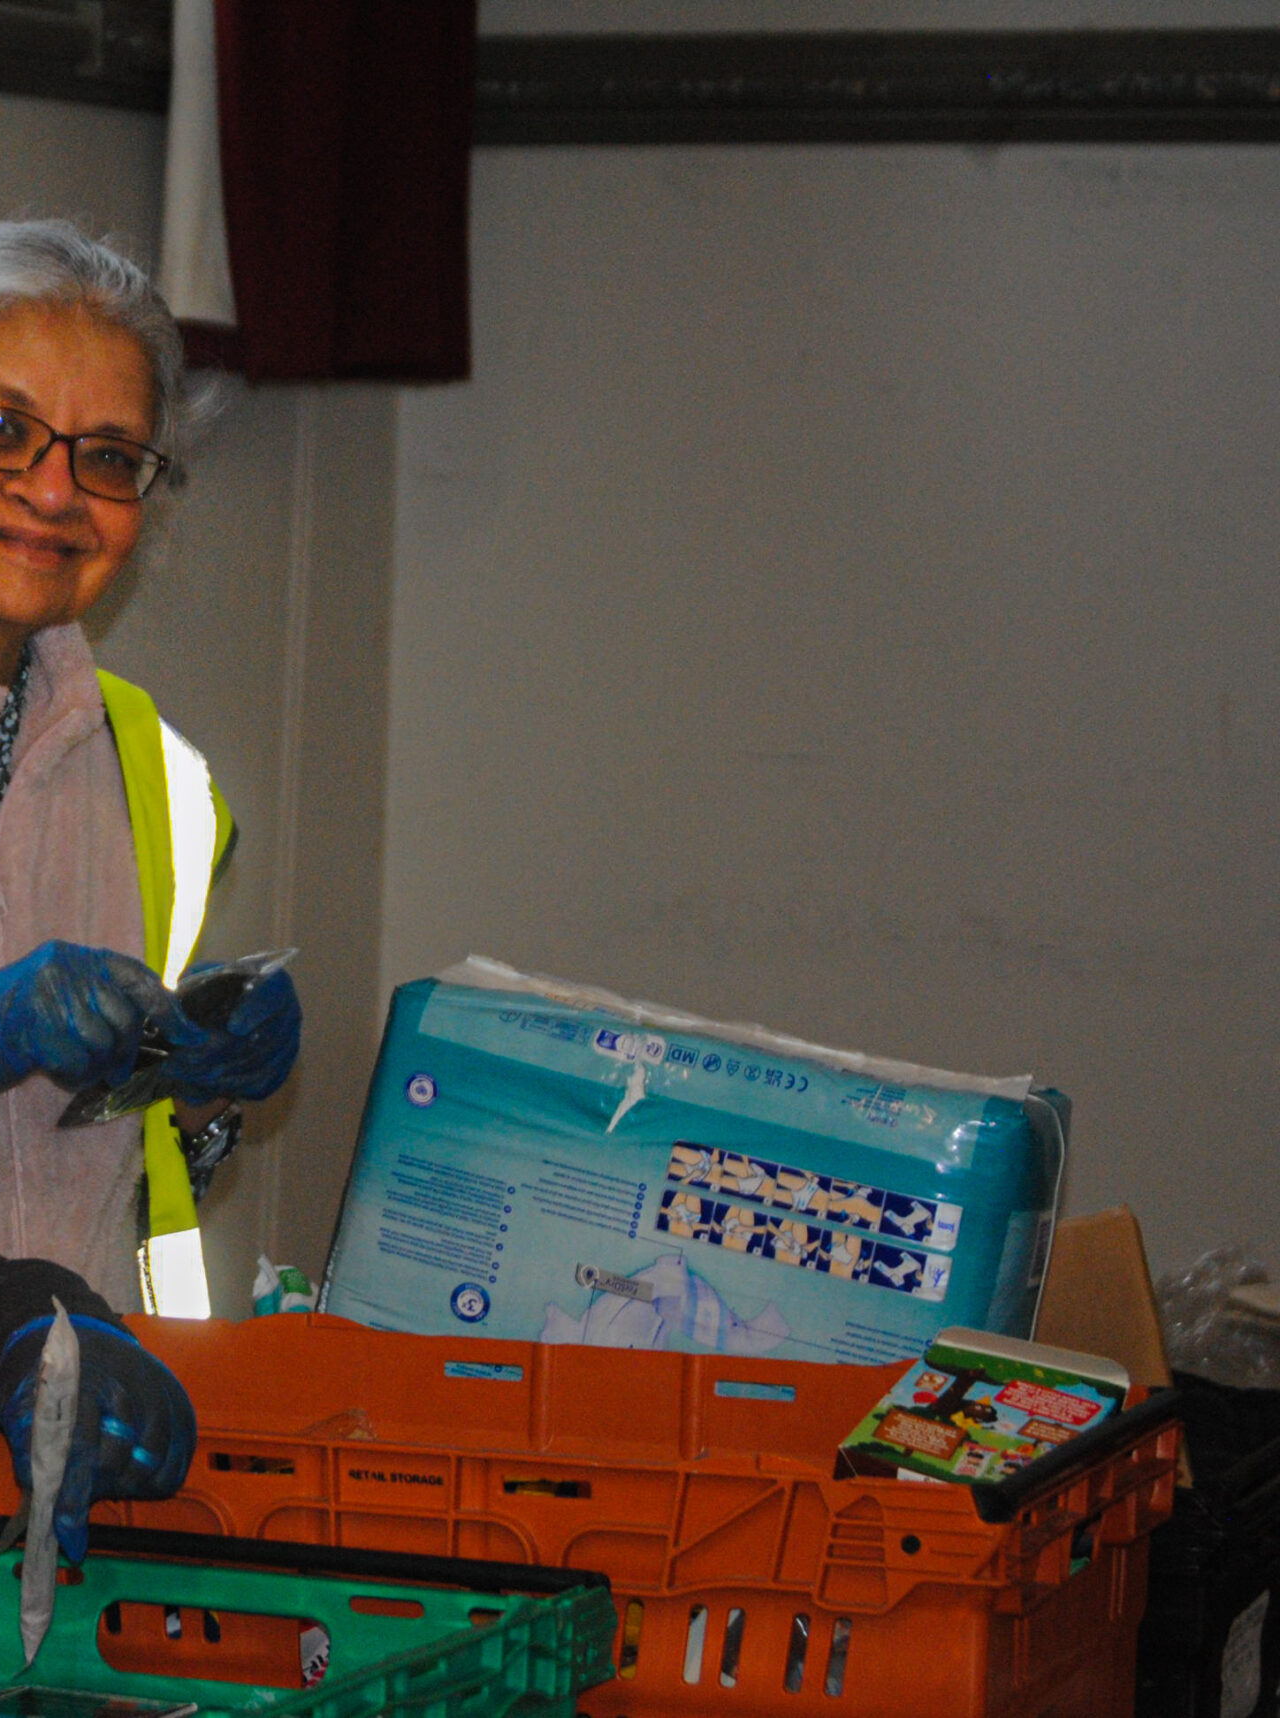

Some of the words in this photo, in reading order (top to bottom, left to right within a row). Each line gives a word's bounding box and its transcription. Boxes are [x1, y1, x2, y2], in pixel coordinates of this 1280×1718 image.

[671, 1048, 696, 1063] MD
[348, 1469, 387, 1482] RETAIL
[390, 1472, 444, 1486] STORAGE
